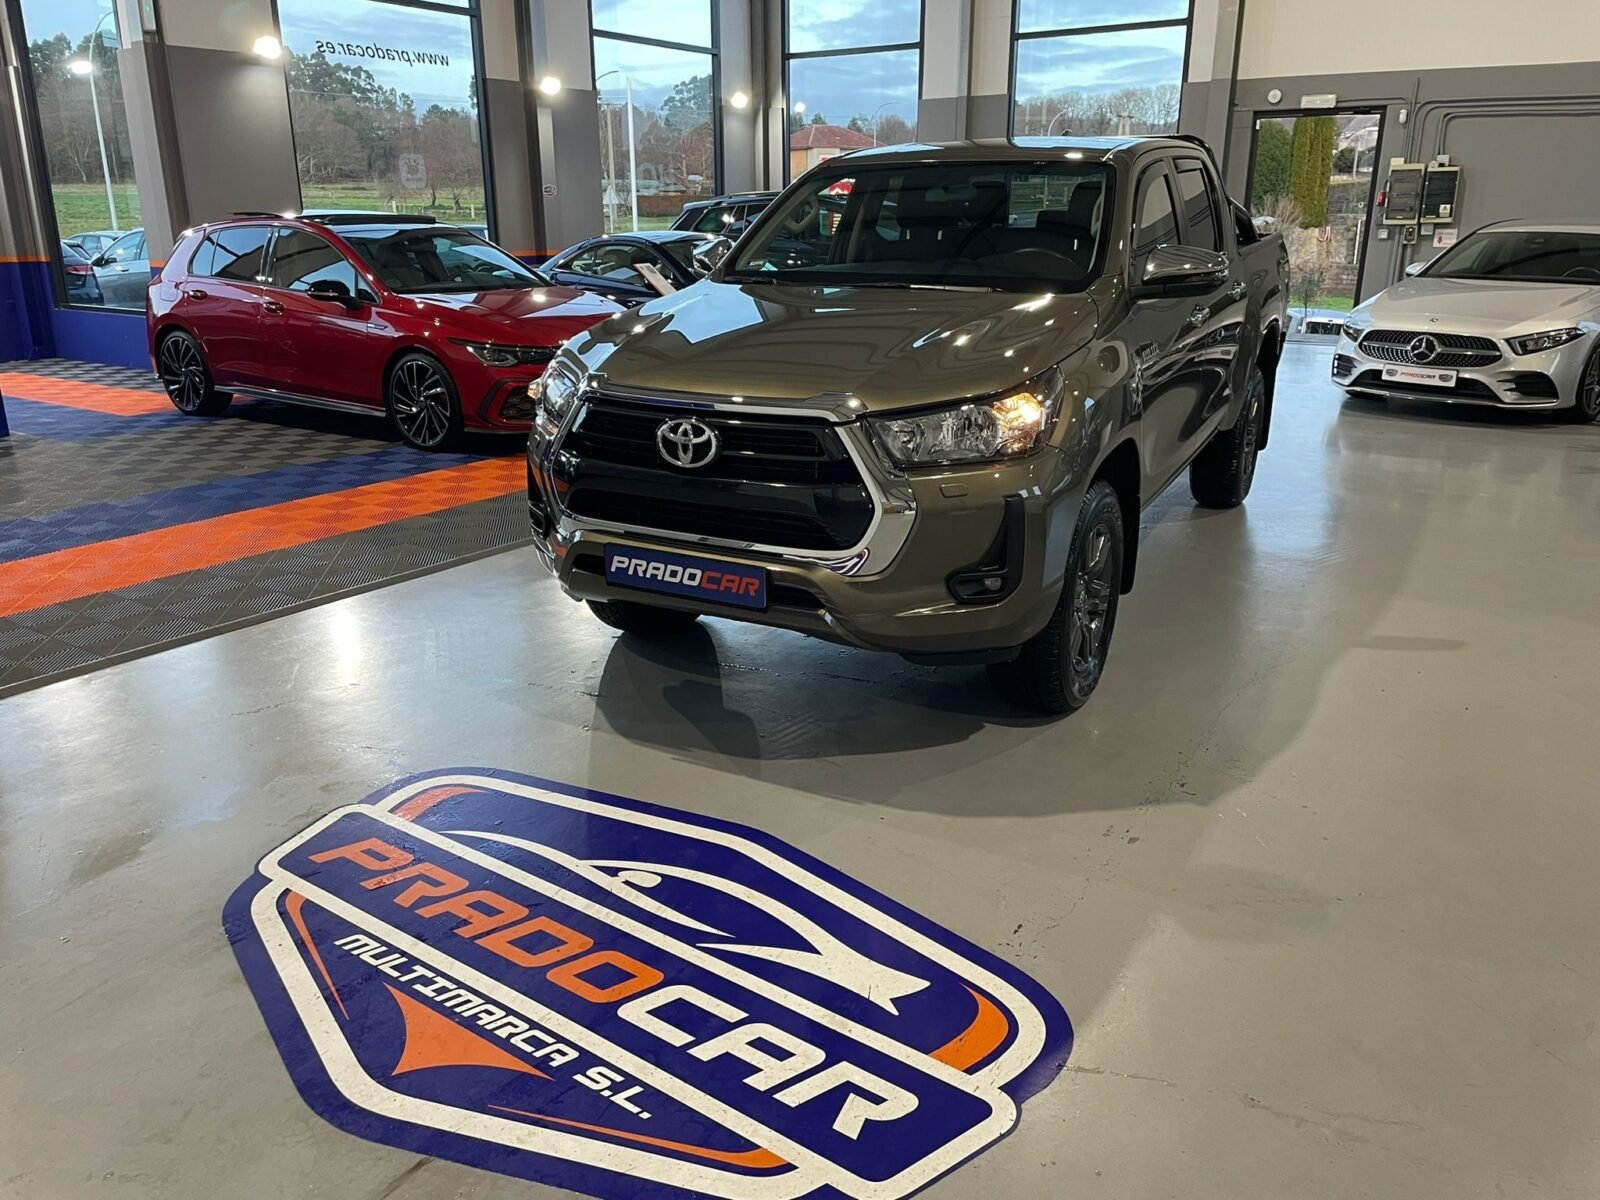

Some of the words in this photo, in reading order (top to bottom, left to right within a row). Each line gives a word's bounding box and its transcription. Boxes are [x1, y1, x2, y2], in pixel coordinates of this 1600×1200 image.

[610, 555, 760, 597] PRADOCAR
[307, 838, 919, 1141] PRADOCAR
[333, 934, 580, 1067] MULTIMARCA
[573, 1065, 653, 1120] S.L.
